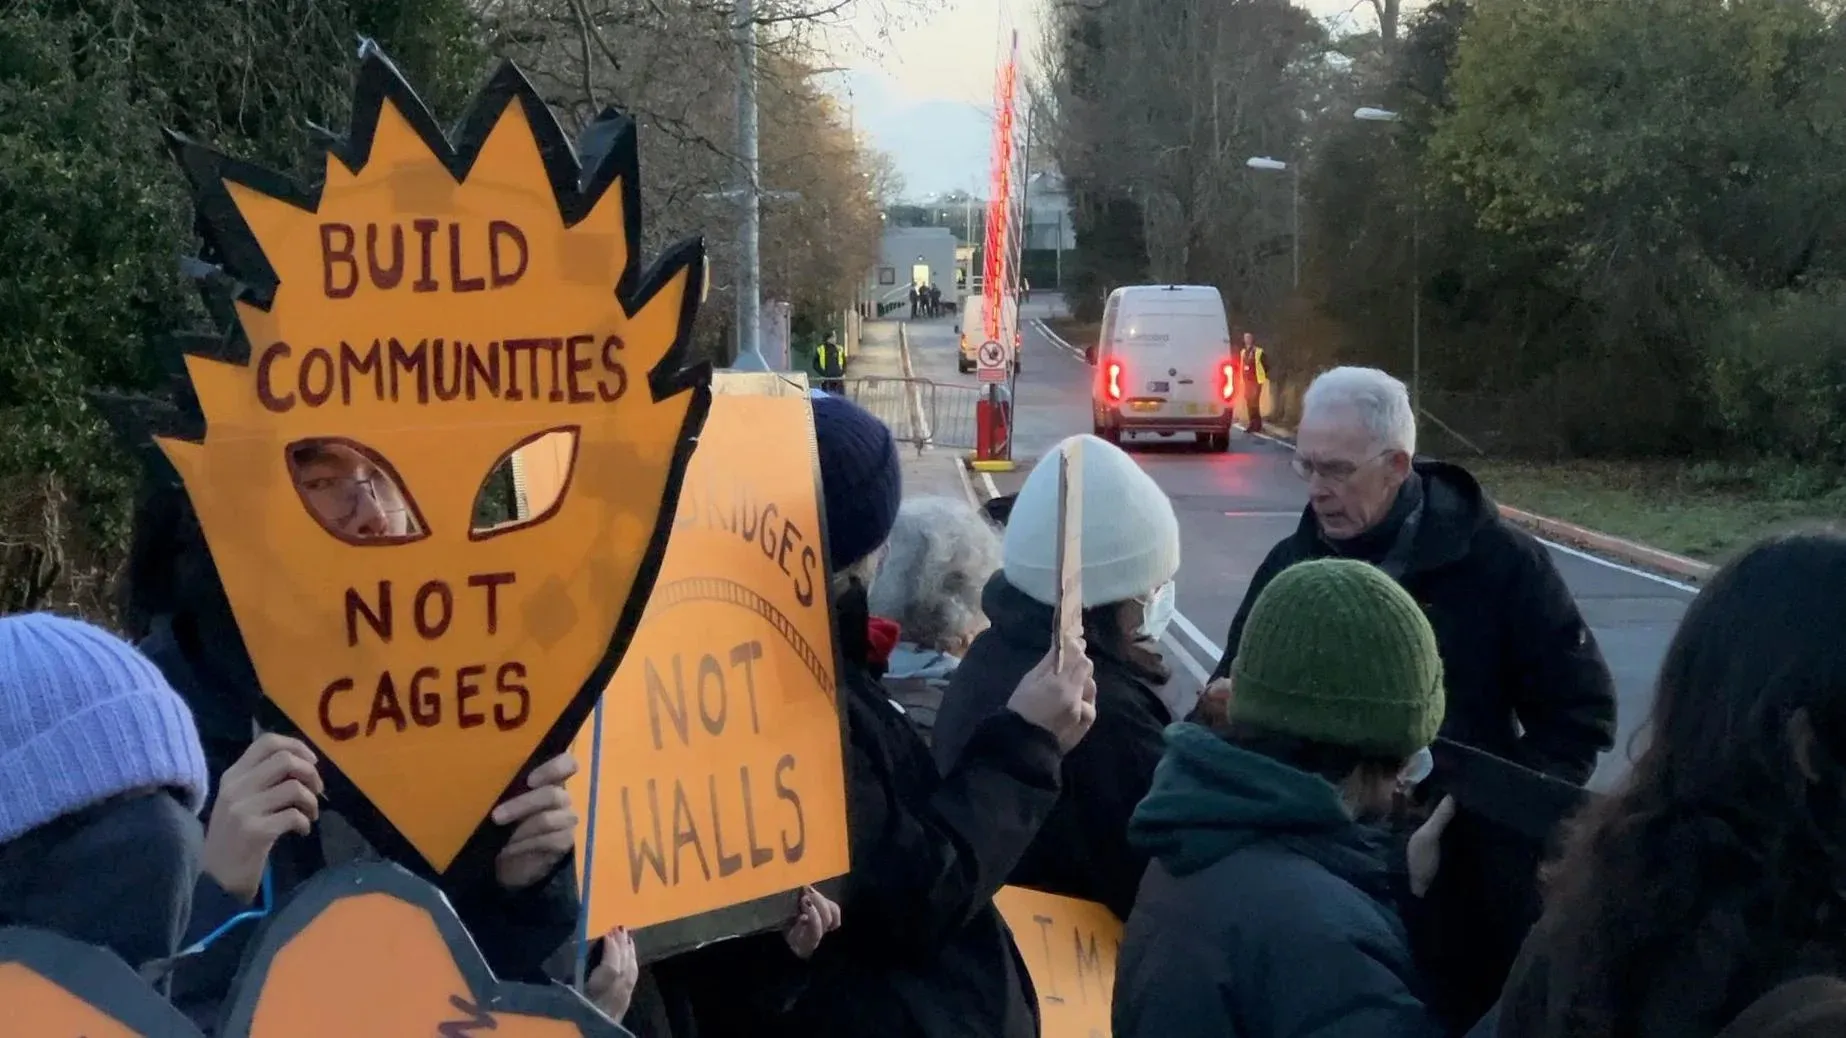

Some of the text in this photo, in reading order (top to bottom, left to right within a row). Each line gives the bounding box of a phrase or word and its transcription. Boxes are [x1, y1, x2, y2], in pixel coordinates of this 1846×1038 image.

[319, 219, 529, 299] BUILD
[256, 334, 627, 413] COMMUNITIES
[344, 572, 516, 648] NOT
[317, 661, 531, 742] CAGES
[644, 640, 763, 751] NOT
[620, 754, 807, 895] WALLS
